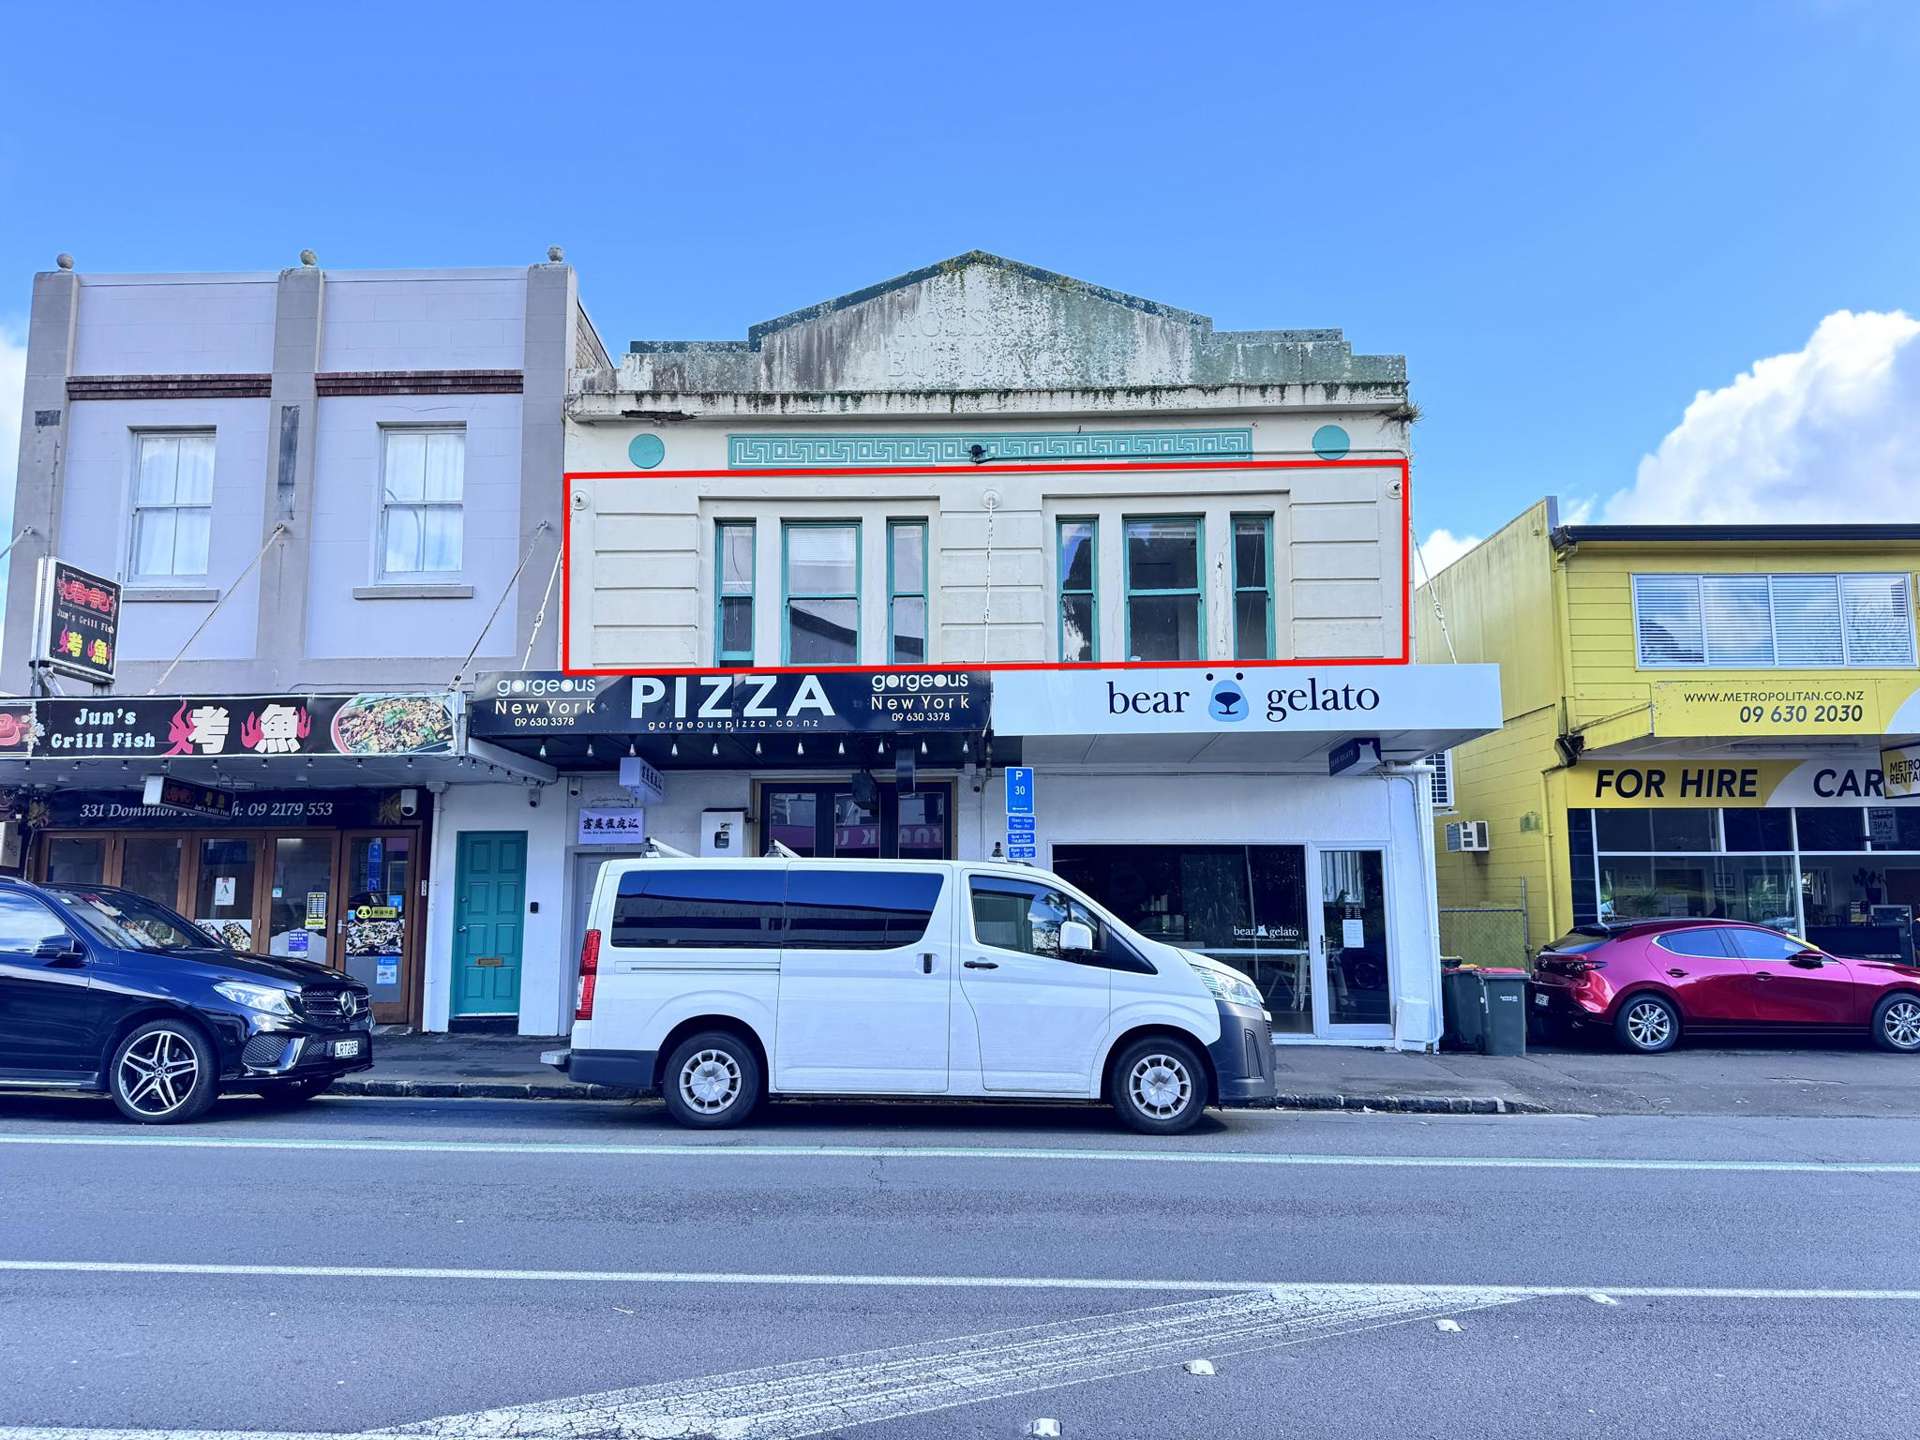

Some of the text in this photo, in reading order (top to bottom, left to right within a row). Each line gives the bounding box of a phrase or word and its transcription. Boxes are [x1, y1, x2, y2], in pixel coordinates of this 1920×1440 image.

[79, 615, 98, 629] Grill
[496, 678, 596, 697] gorgeous
[871, 673, 969, 693] gorgeous
[630, 674, 836, 719] PIZZA
[871, 695, 970, 710] New York
[1106, 677, 1380, 723] bear gelato
[1684, 690, 1865, 702] WWW.METROPOLITAN.CO.NZ
[495, 699, 596, 715] New York
[1739, 705, 1864, 723] 09 630 2030
[75, 708, 137, 725] Jun's
[514, 717, 575, 727] 09 630 3378
[891, 712, 951, 722] 09 630 3378
[648, 719, 819, 731] gorgeouspizza.co.nz
[51, 733, 156, 749] Grill Fish
[1015, 770, 1024, 781] P
[1890, 771, 1920, 785] RENTA
[1014, 785, 1026, 795] 30
[1595, 768, 1758, 799] FOR HIRE
[80, 804, 104, 818] 331
[248, 802, 269, 817] 09
[270, 802, 303, 816] 2179
[306, 802, 334, 816] 553
[1233, 925, 1299, 938] bear gelato
